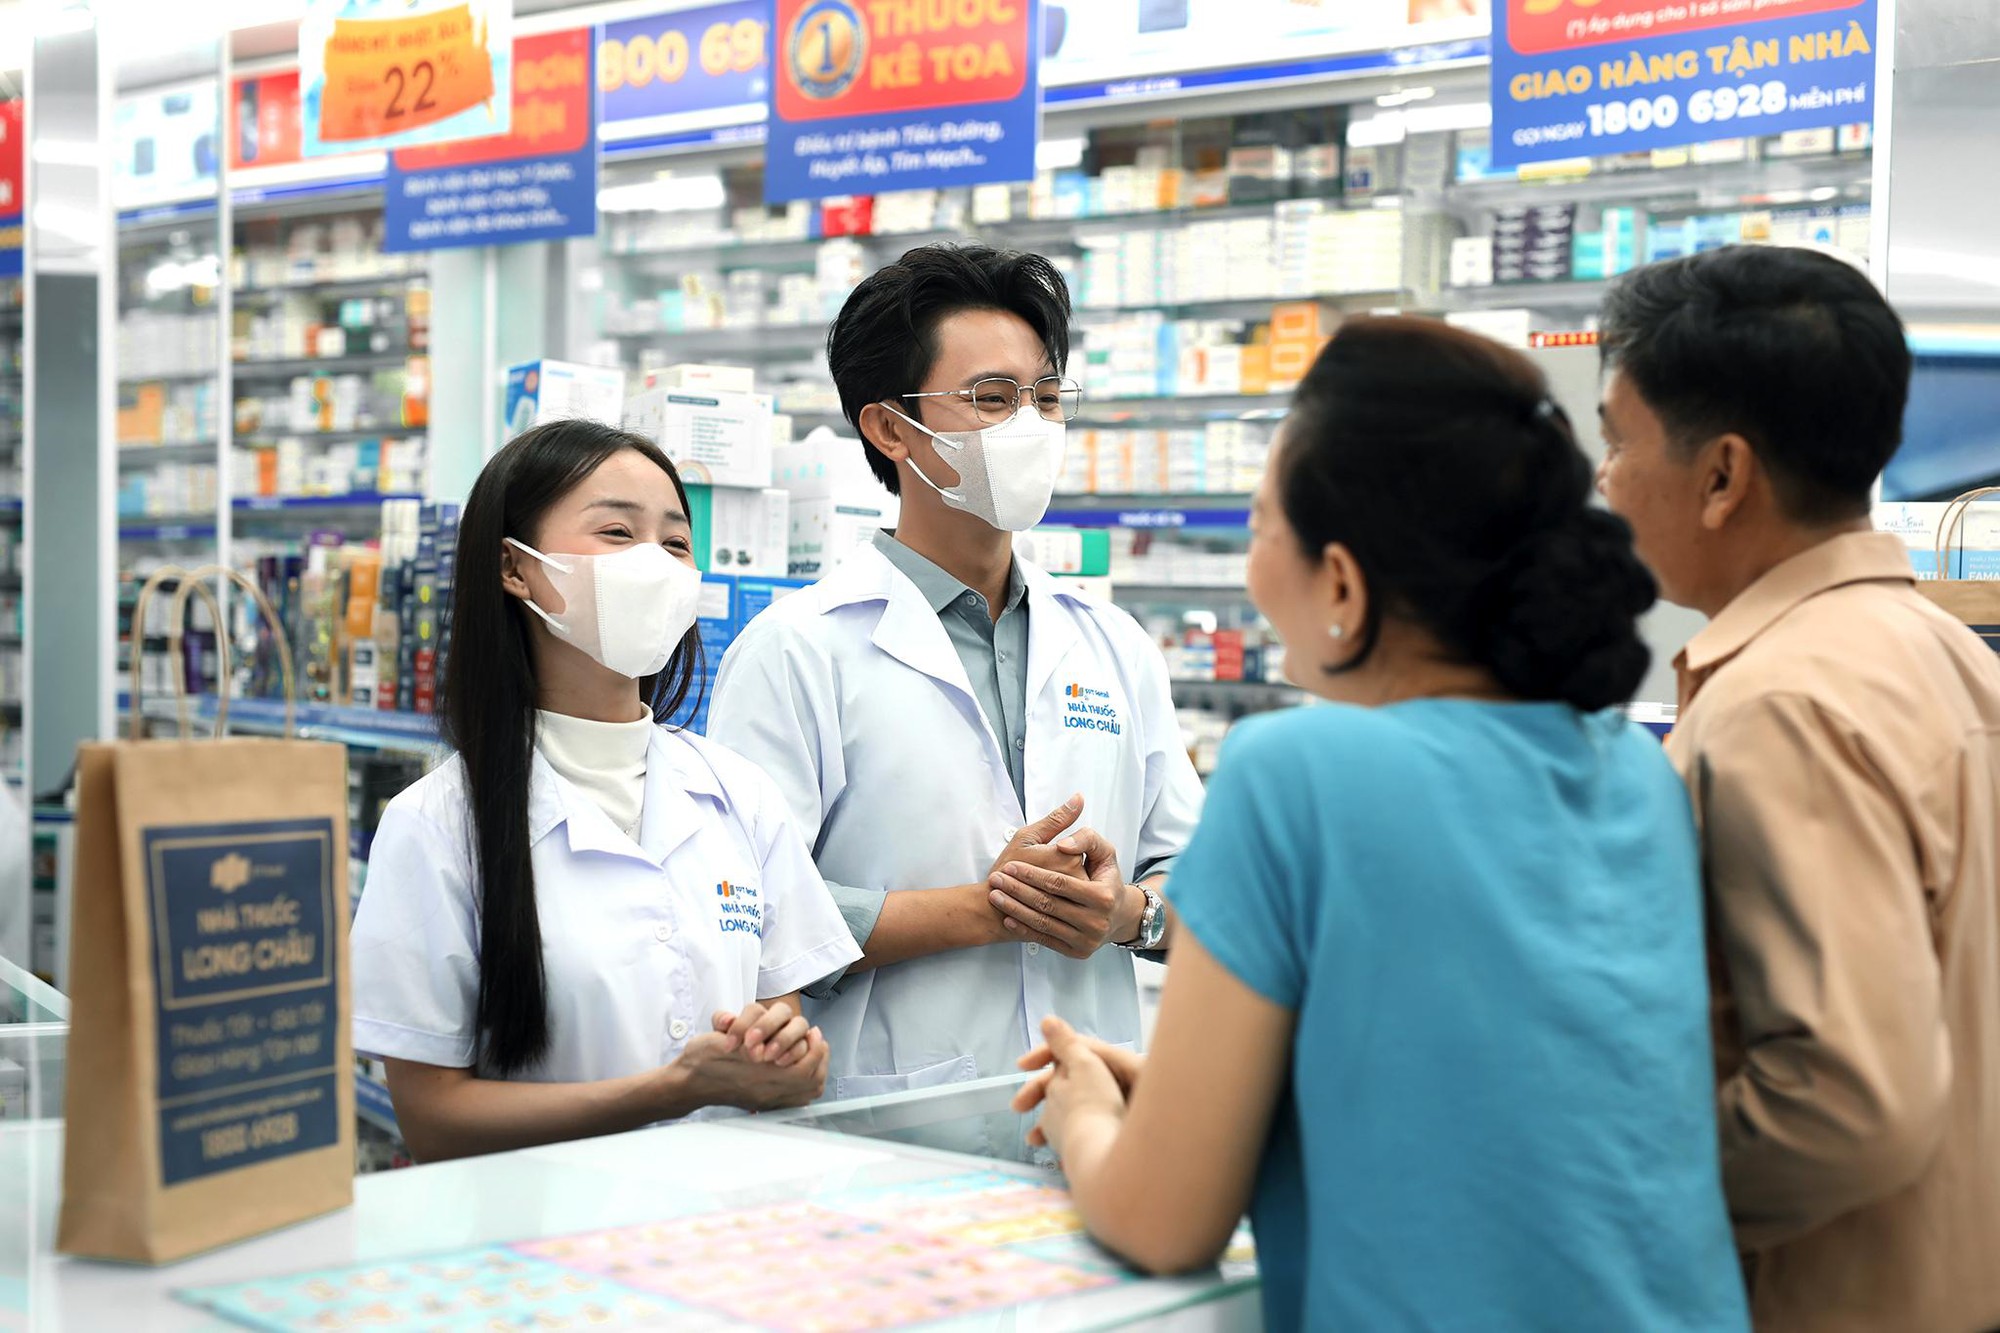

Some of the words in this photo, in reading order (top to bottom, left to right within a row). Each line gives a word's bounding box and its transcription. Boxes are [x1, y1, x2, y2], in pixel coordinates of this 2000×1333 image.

[869, 42, 922, 90] KÊ
[928, 41, 1014, 84] TOA
[1509, 65, 1593, 102] GIAO
[1600, 51, 1699, 90] HÀNG
[1705, 35, 1780, 78] TẬN
[1788, 20, 1871, 64] NHÀ
[1586, 94, 1679, 137] 1800
[1687, 80, 1788, 124] 6928
[1063, 715, 1096, 729] LONG
[1096, 718, 1121, 736] CHÂU
[1067, 701, 1088, 713] NHÀ
[1087, 704, 1117, 718] THUỐC
[720, 900, 742, 913] NHÀ
[719, 918, 750, 933] LONG
[182, 941, 251, 982] LONG
[253, 928, 316, 971] CHÂU
